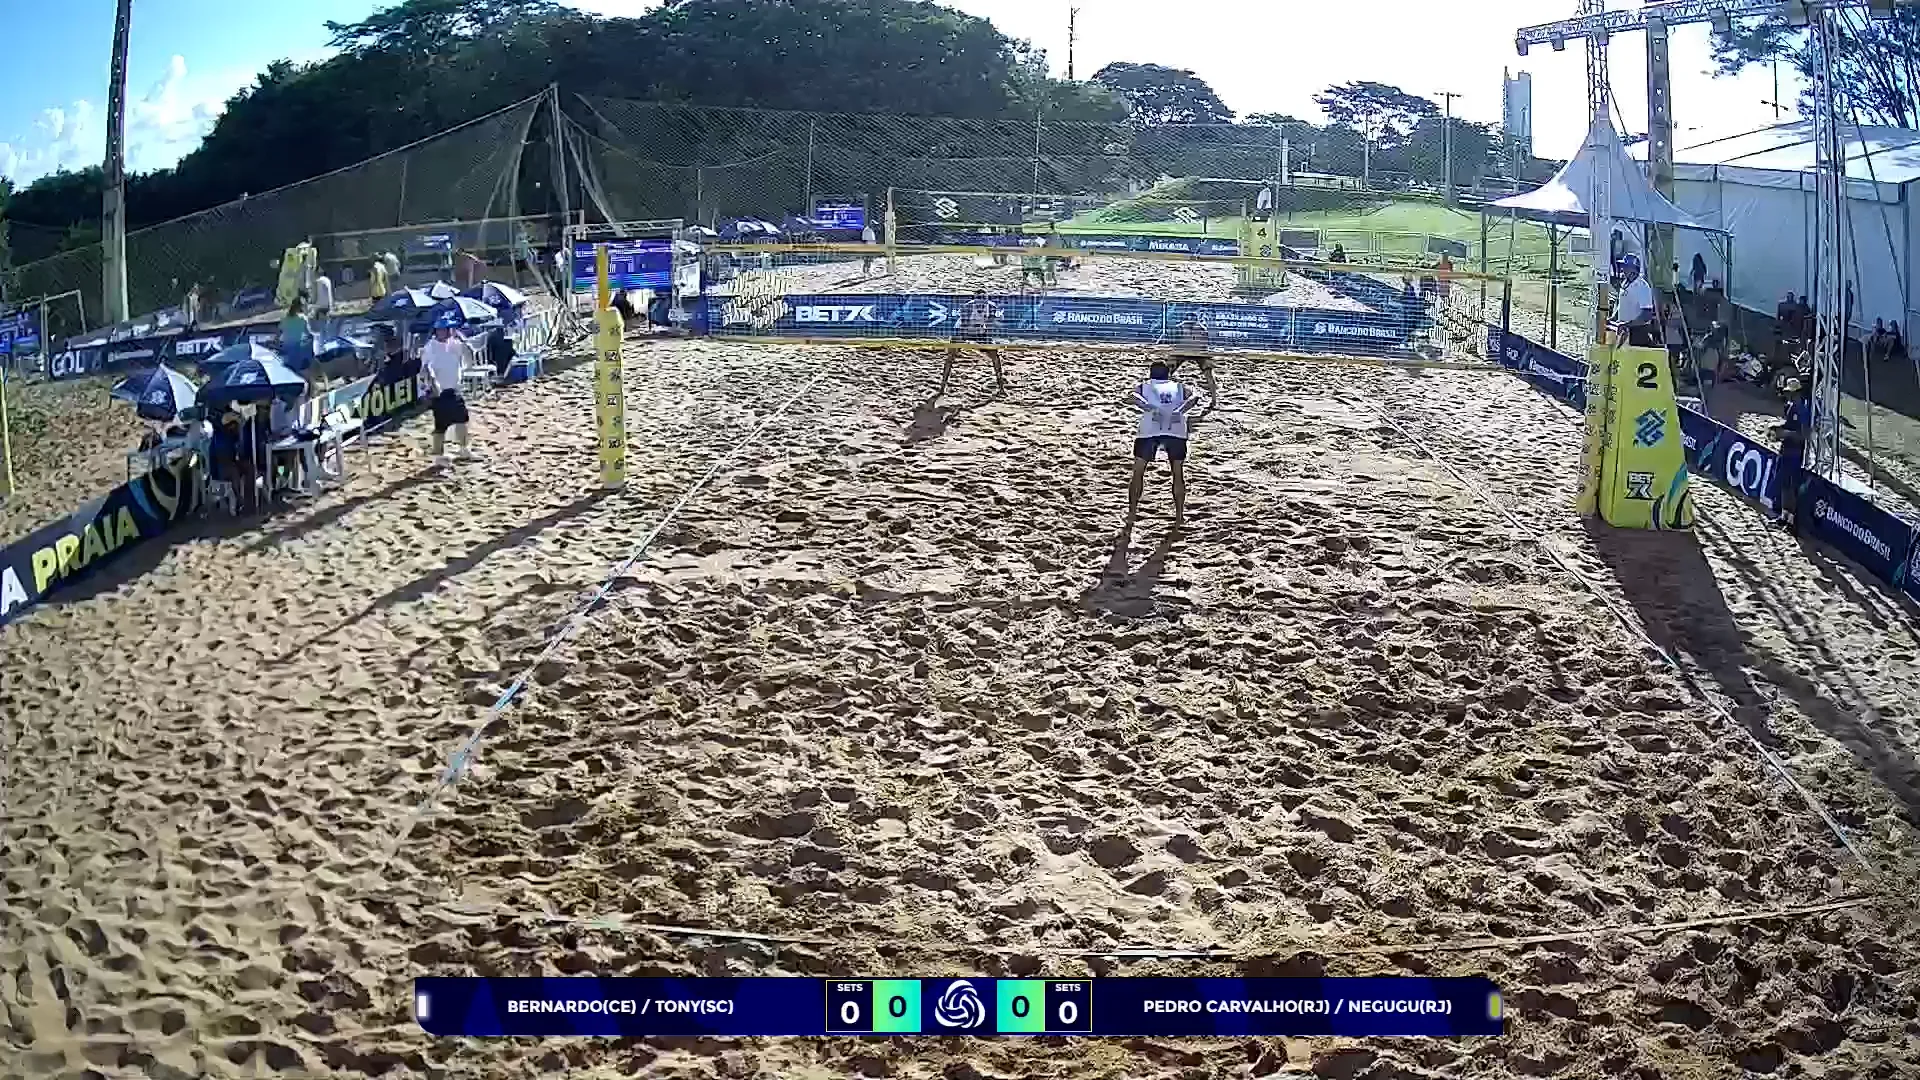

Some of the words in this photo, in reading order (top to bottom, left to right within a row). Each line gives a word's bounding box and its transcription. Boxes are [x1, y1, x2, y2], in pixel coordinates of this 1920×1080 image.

[1256, 227, 1267, 239] 4
[52, 350, 84, 376] GOL
[1636, 362, 1659, 390] 2
[1726, 442, 1773, 509] GOL
[31, 505, 141, 595] PRAIA
[1826, 506, 1853, 533] BANCO
[1863, 528, 1891, 561] BRASIL
